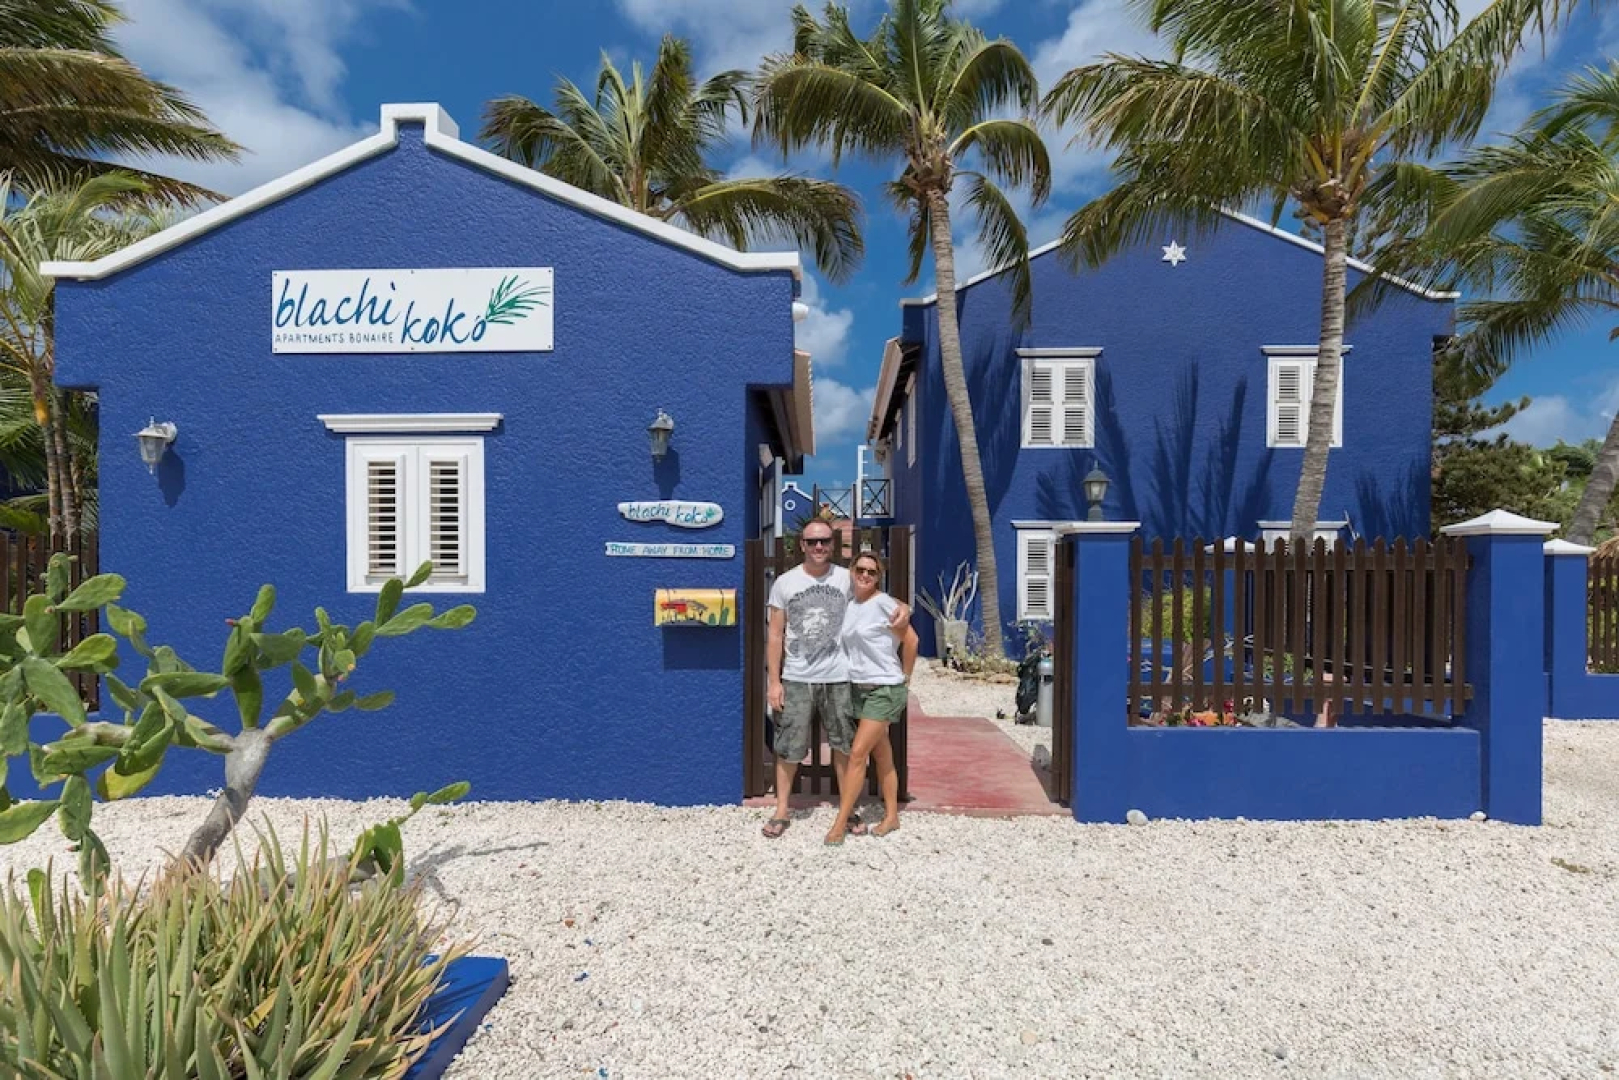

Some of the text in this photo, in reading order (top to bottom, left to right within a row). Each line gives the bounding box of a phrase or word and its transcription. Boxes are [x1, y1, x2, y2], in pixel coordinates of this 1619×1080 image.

[275, 278, 401, 328] blachi
[275, 332, 394, 344] APARTMENTS BONAIRE
[610, 543, 730, 555] HOME AWAY FROM HOME
